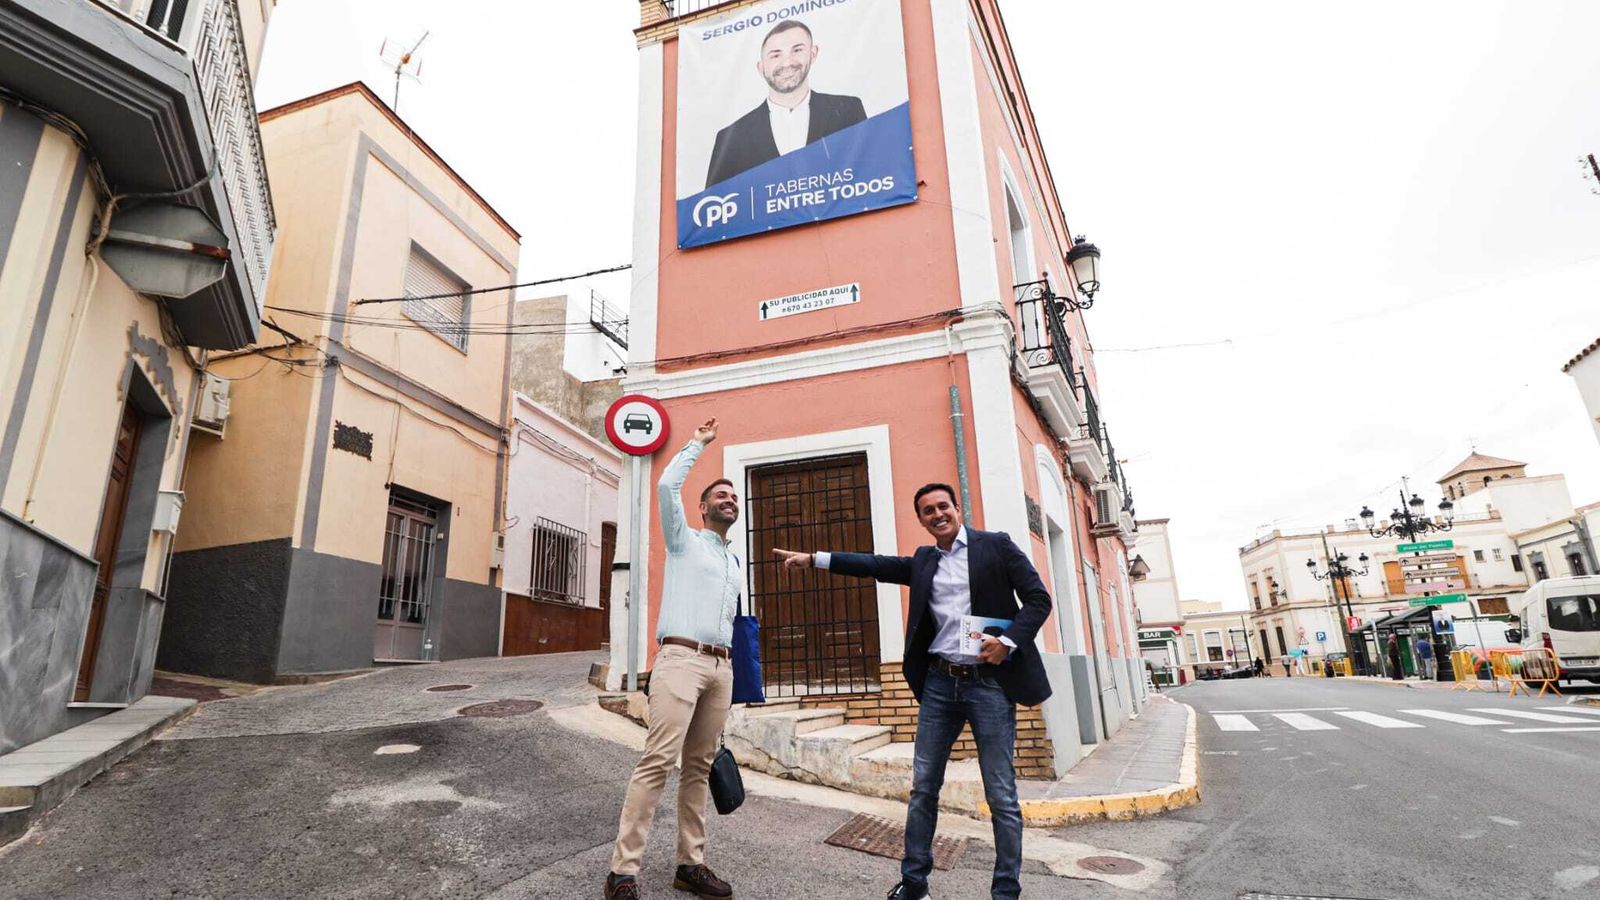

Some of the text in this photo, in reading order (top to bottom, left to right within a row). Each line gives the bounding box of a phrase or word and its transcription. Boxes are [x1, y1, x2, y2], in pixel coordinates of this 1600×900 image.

[702, 16, 763, 41] SERGIO
[765, 168, 854, 197] TABERNAS
[766, 176, 895, 214] ENTRE TODOS
[769, 299, 780, 308] SU
[782, 290, 827, 304] PUBLICIDAD
